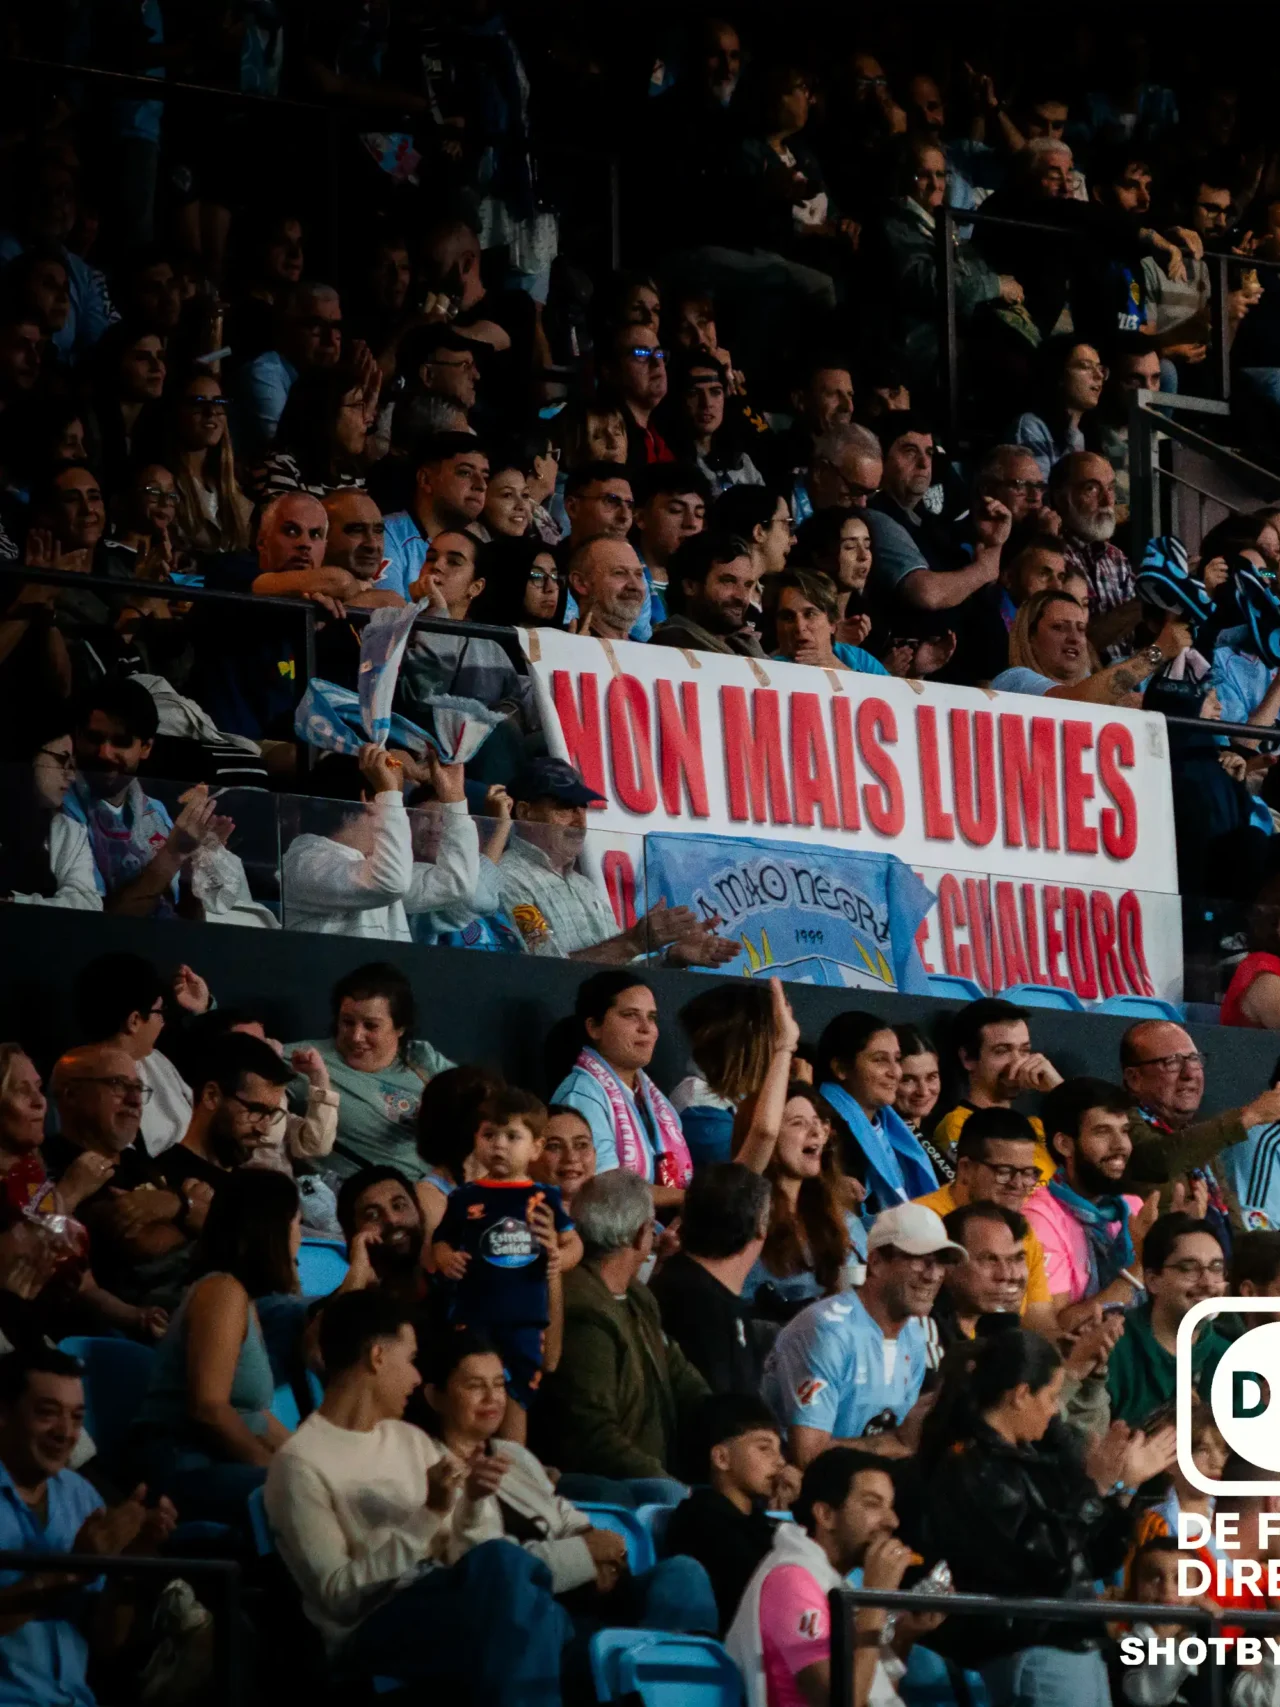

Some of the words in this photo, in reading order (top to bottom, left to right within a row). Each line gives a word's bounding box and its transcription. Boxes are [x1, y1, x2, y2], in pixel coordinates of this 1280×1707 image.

[552, 669, 709, 818] NON
[720, 684, 905, 837] MAIS
[916, 704, 1137, 860] LUMES
[795, 928, 824, 944] 1999
[938, 873, 1156, 999] CUALEDRO
